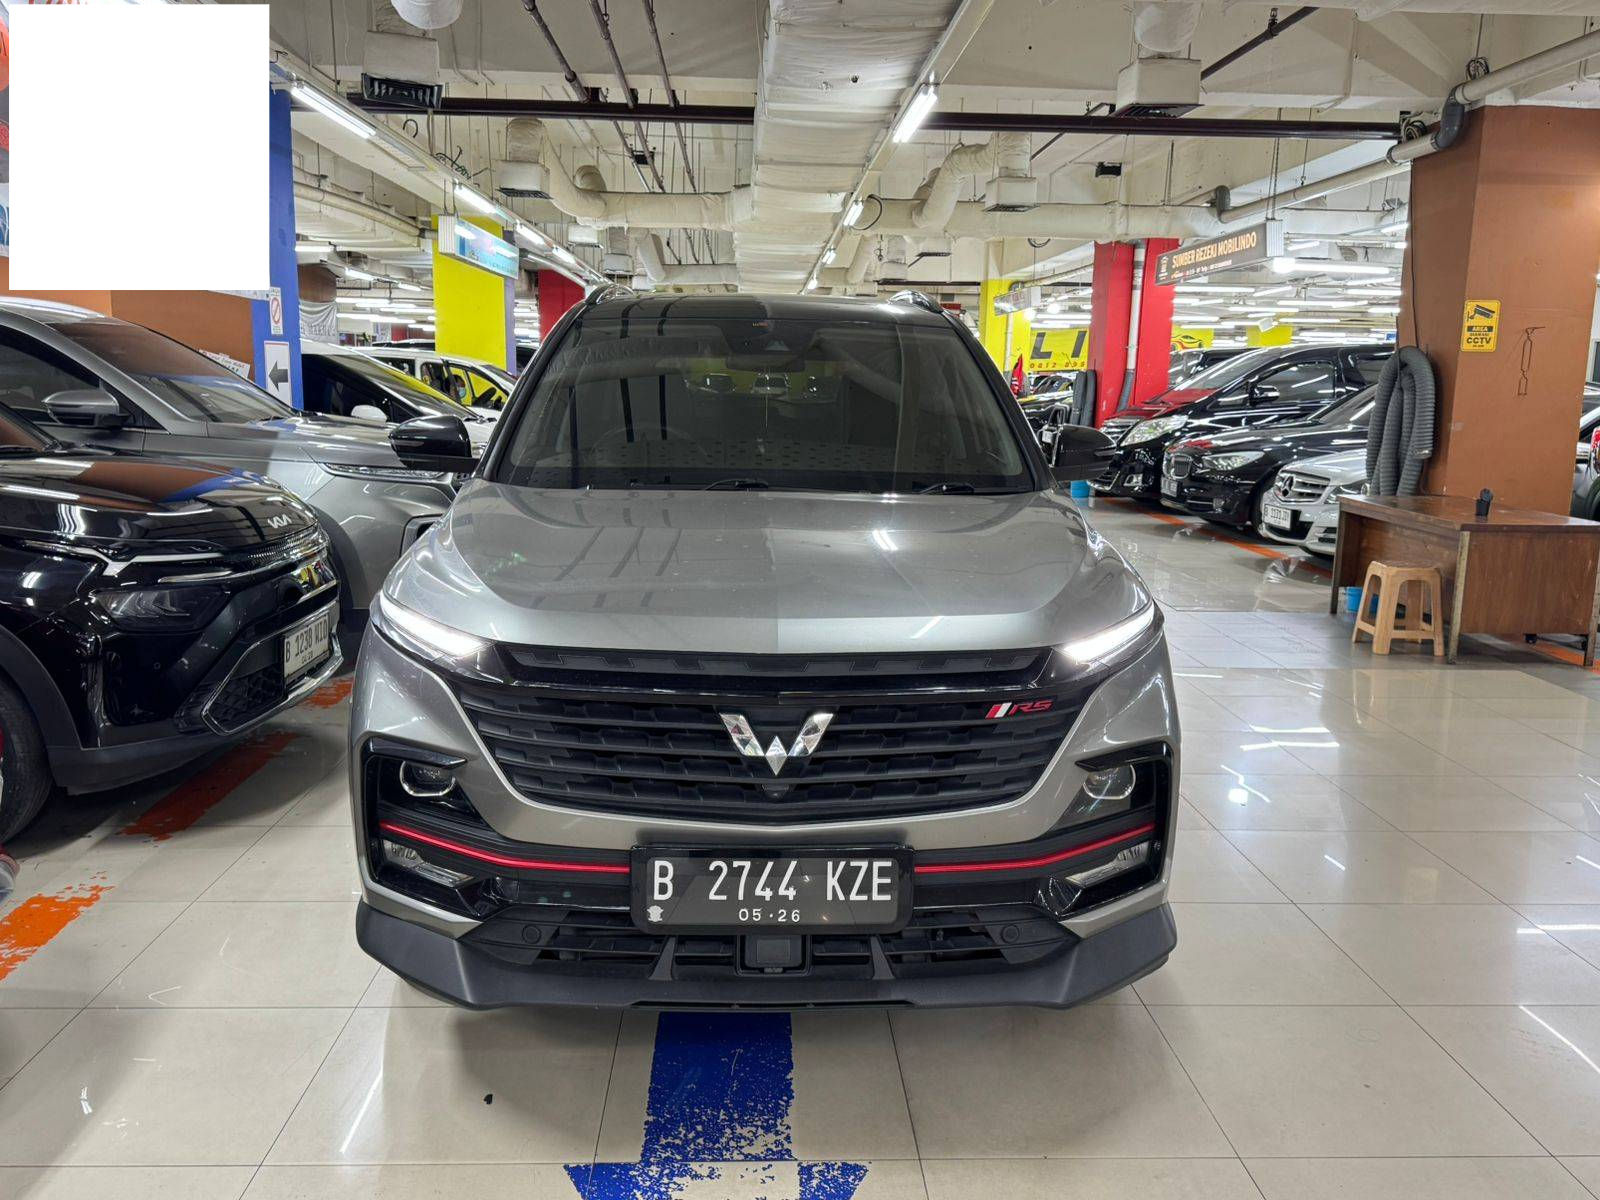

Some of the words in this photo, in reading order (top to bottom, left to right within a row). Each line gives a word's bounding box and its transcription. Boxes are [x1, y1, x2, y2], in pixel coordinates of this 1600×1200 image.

[1172, 249, 1196, 269] SUMBER
[1196, 243, 1217, 262] REZEKI
[1217, 232, 1257, 256] MOBILINDO
[267, 513, 292, 529] KIA
[285, 640, 291, 663] B
[1008, 699, 1053, 716] RS
[653, 860, 674, 901] B
[708, 860, 798, 901] 2744
[826, 860, 892, 901] KZE
